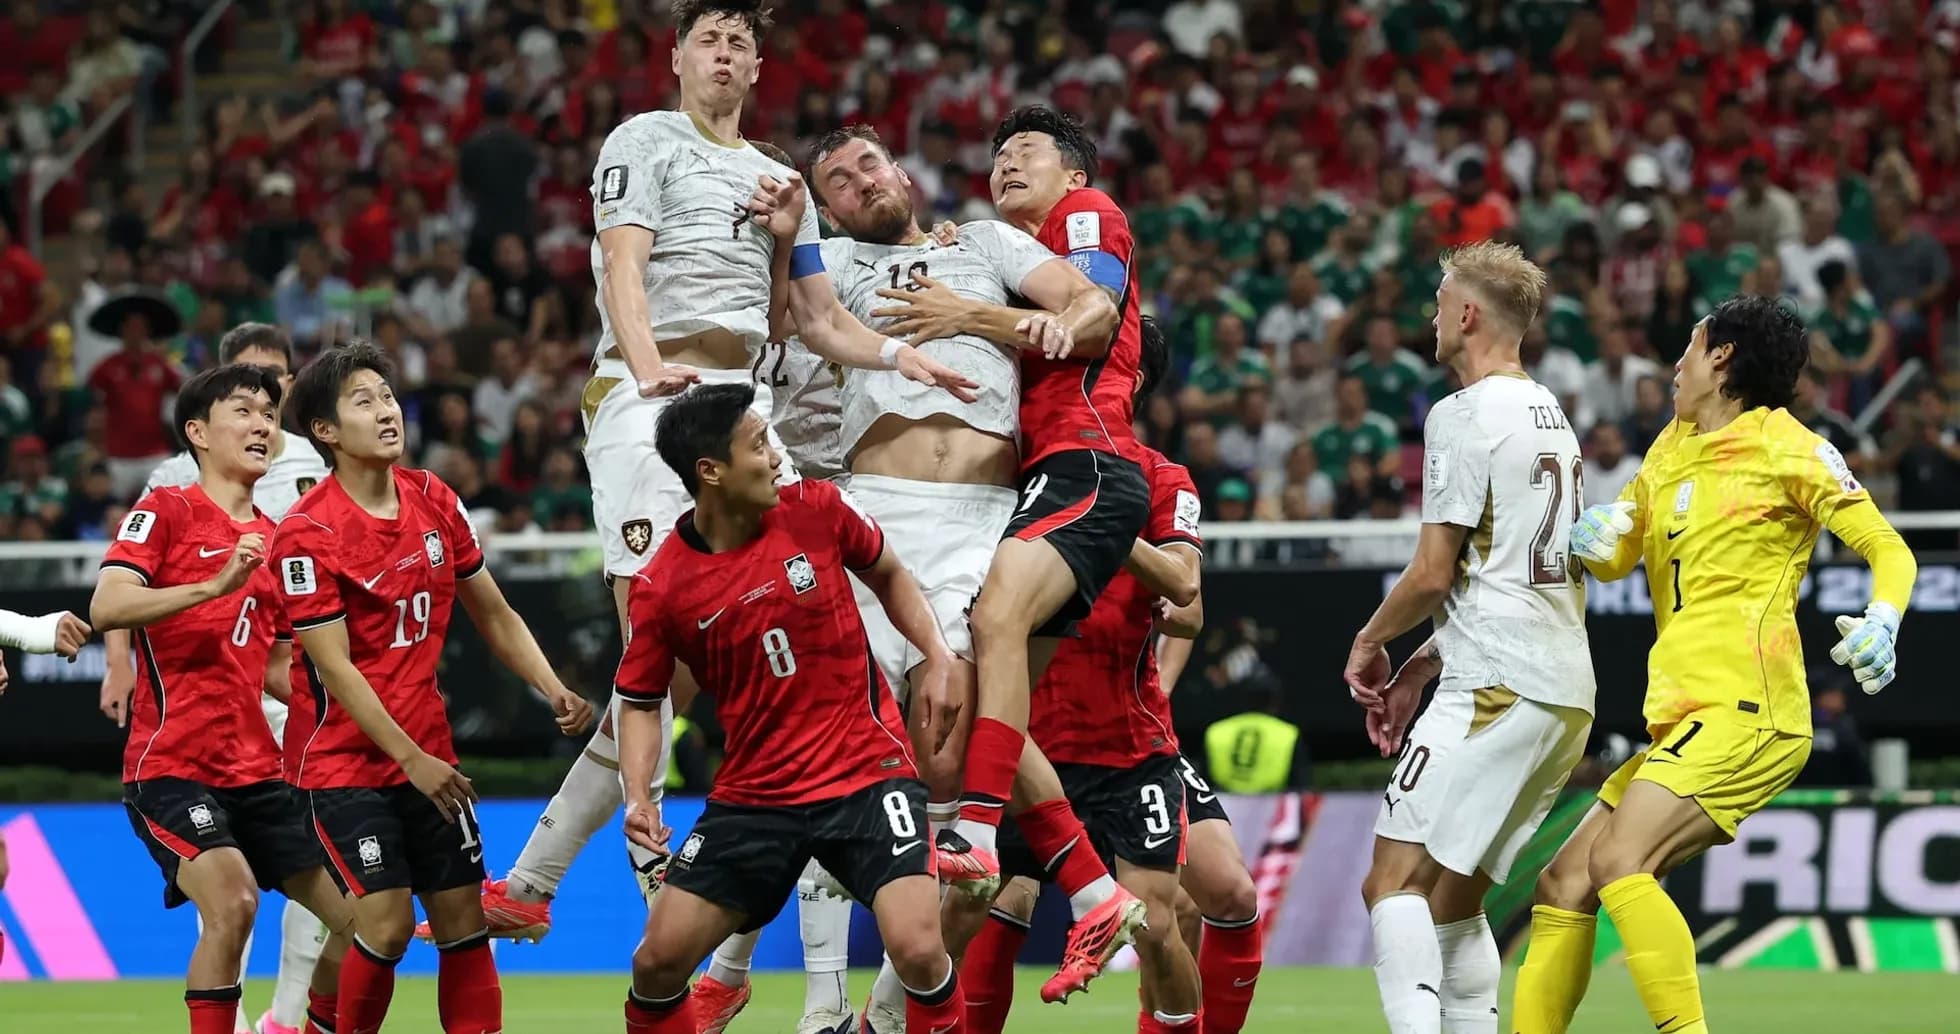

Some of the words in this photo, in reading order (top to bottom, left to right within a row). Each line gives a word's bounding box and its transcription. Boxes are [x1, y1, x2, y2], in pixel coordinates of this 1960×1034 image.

[1019, 473, 1049, 511] 4
[1671, 558, 1684, 613] 1
[231, 596, 257, 648] 6
[389, 591, 431, 649] 19
[762, 627, 797, 678] 8
[1661, 720, 1704, 758] 1
[882, 790, 917, 838] 8
[1140, 783, 1171, 834] 3
